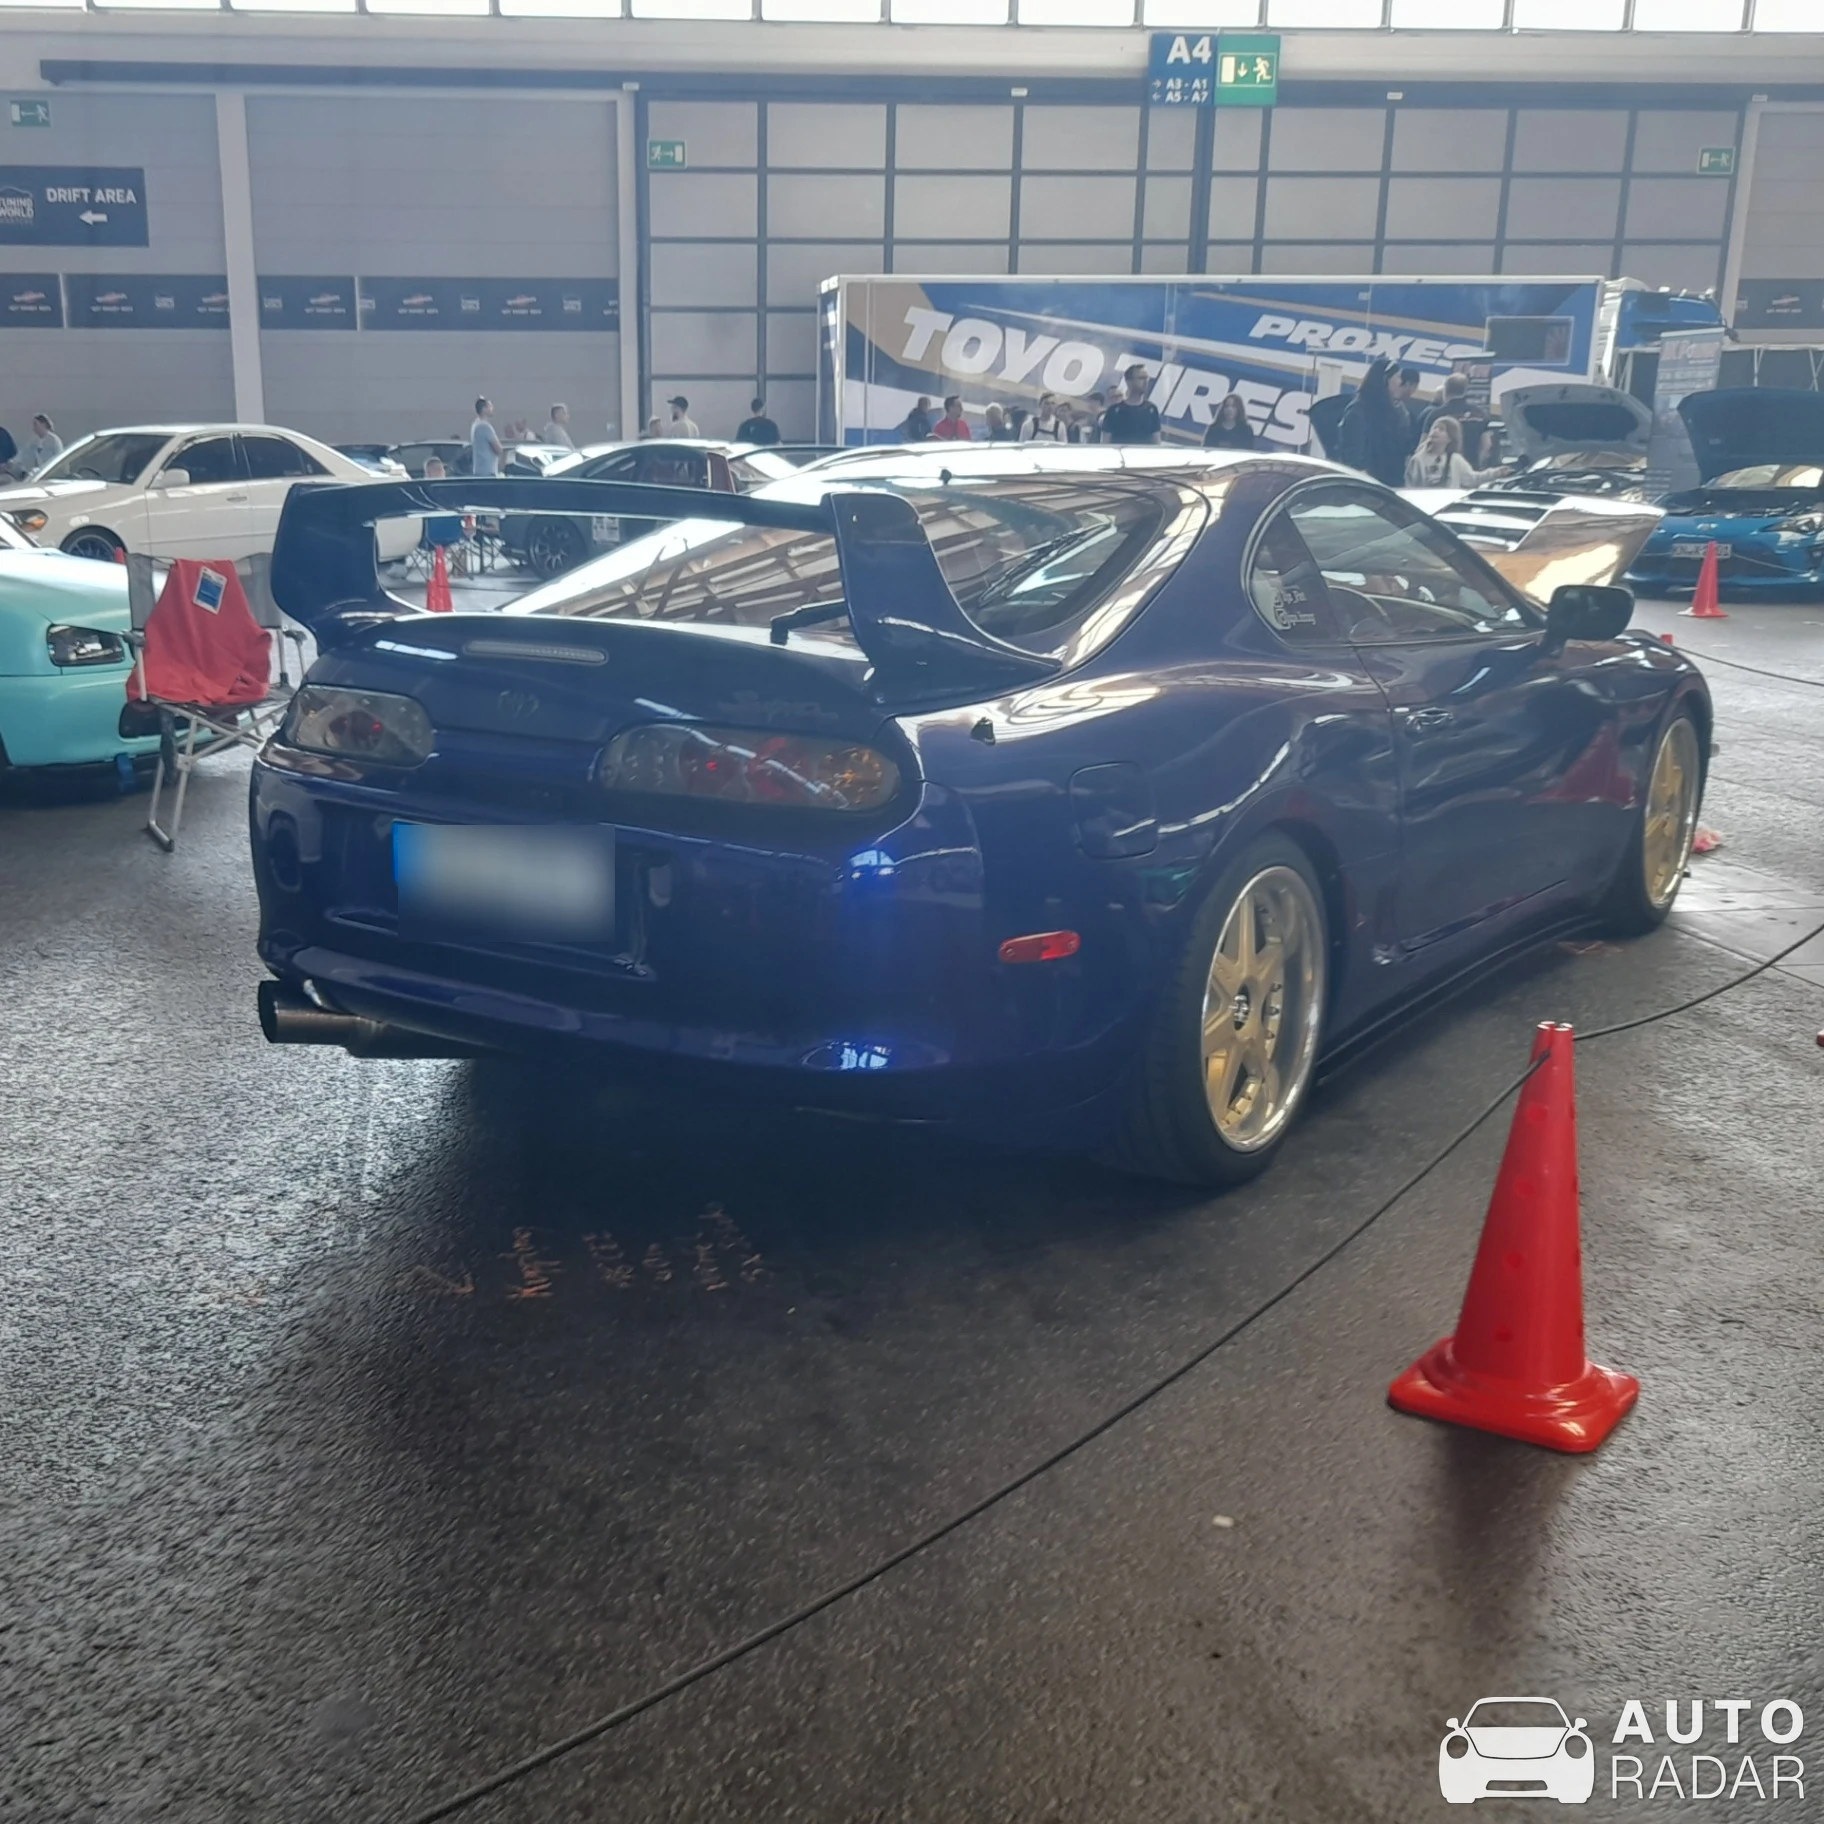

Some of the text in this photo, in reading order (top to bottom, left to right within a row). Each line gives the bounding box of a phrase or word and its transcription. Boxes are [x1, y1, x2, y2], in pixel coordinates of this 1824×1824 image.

[1166, 36, 1212, 65] A4
[1165, 78, 1182, 90] A3
[1191, 78, 1208, 90] A1
[1165, 91, 1182, 103] A5
[1191, 91, 1208, 103] A7
[46, 188, 137, 204] DRIFT AREA
[902, 306, 1105, 396] TOYO
